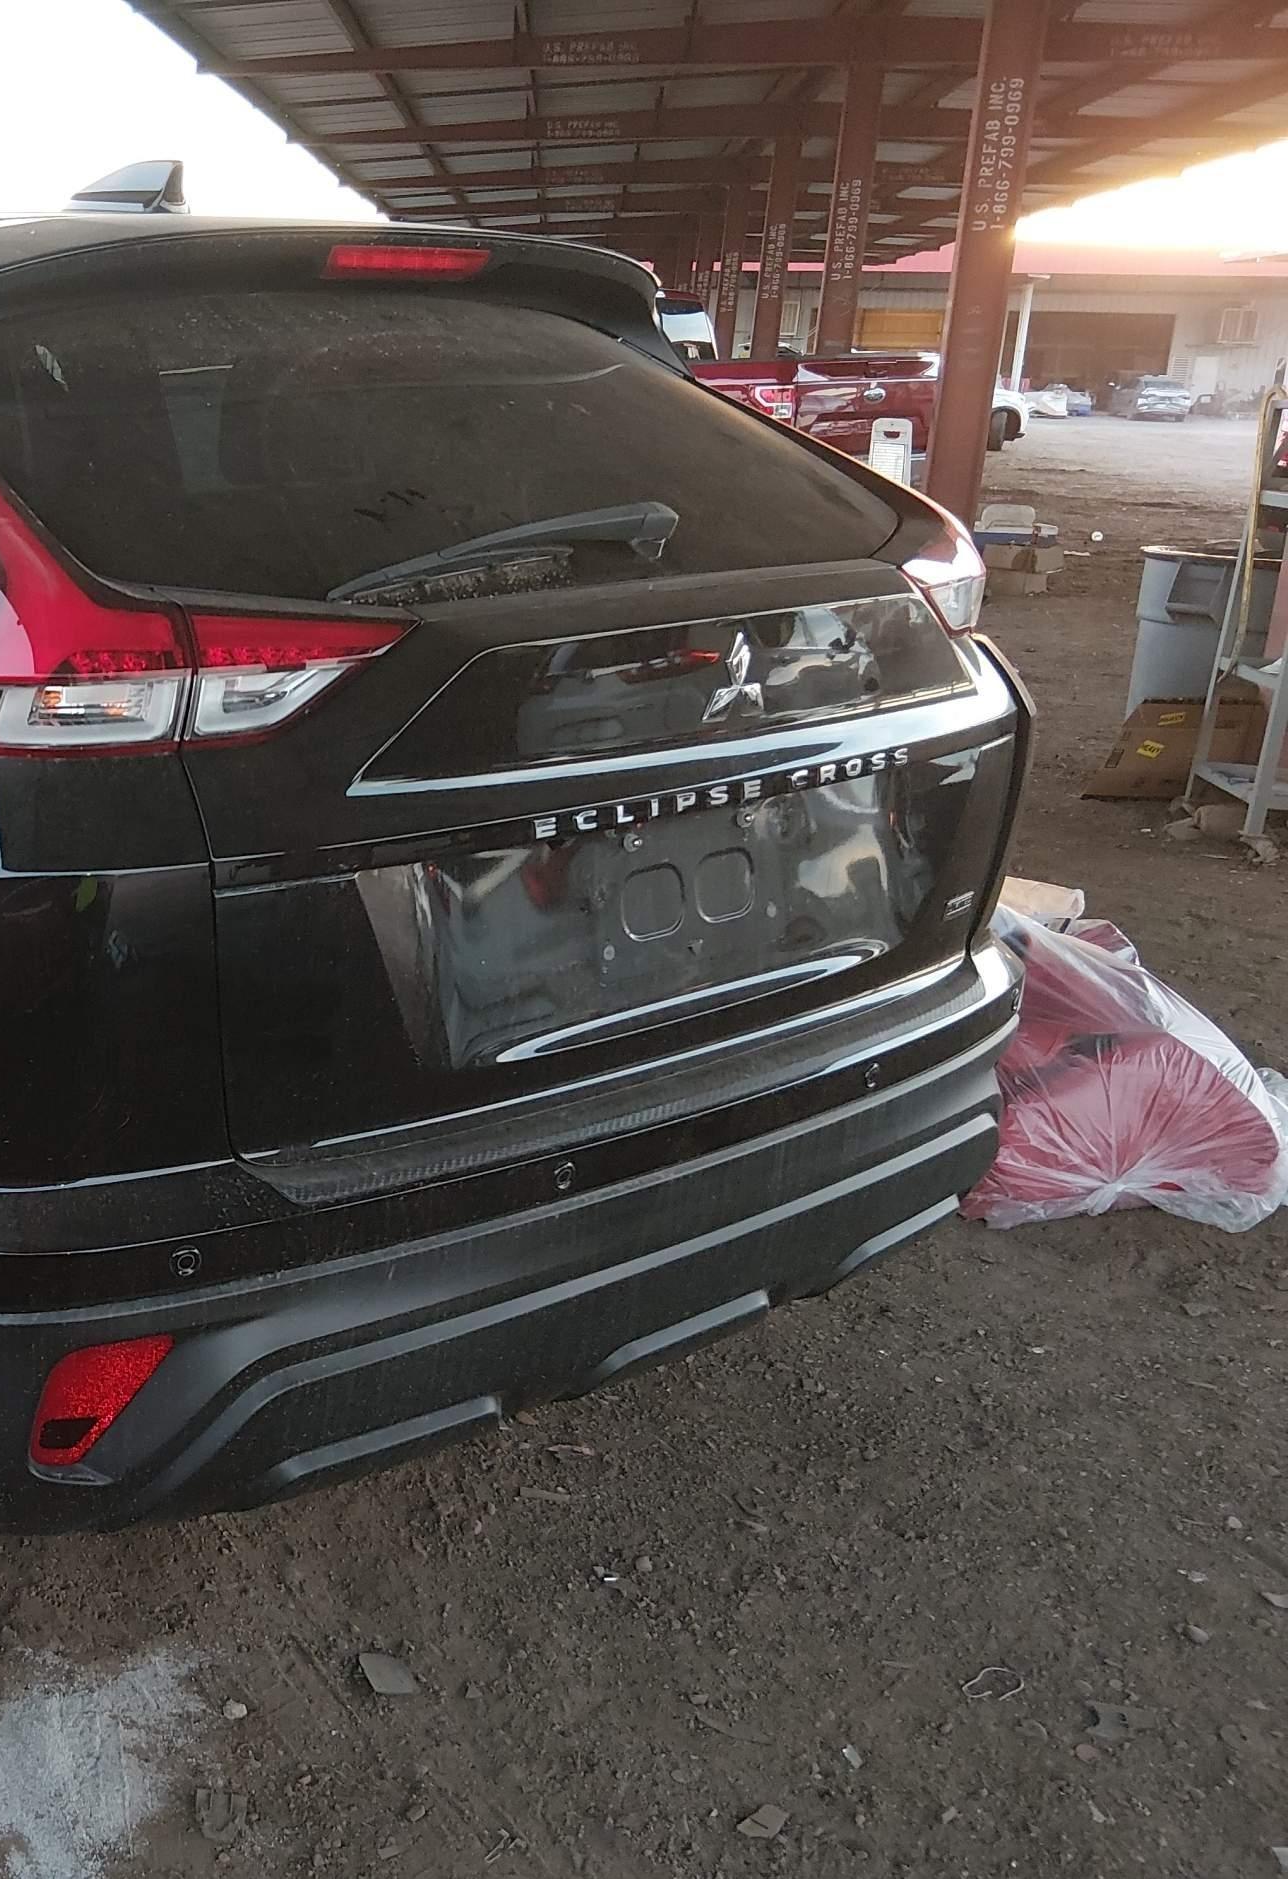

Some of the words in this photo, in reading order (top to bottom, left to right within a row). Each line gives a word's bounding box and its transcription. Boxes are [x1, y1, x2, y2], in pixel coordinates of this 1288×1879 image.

[978, 119, 1001, 188] PREFAB
[990, 77, 1025, 230] 1-866-799-0969
[833, 207, 848, 253] PREFAB
[842, 178, 862, 280] 1-866-799-0969
[533, 778, 763, 840] ECLIPSE
[788, 747, 910, 790] CROSS
